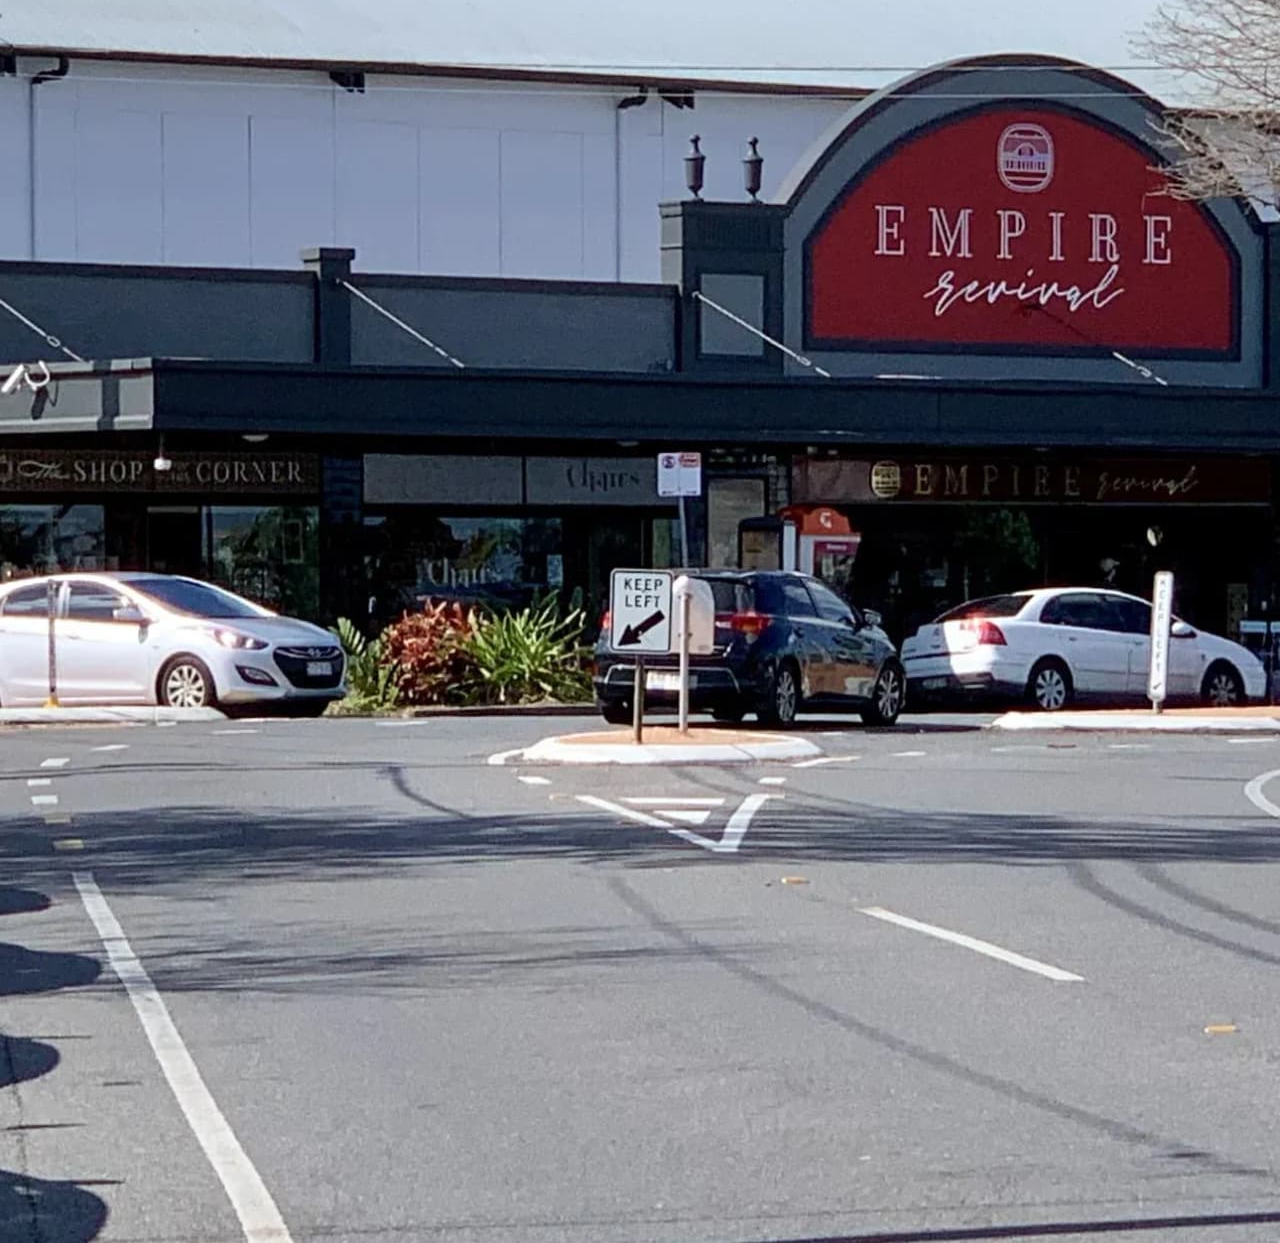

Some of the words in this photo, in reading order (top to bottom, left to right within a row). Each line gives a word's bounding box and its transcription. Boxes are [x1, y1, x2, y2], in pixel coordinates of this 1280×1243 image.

[874, 205, 1172, 264] EMPIRE
[924, 265, 1124, 316] revival
[73, 459, 144, 483] SHOP
[195, 460, 304, 484] CORNER
[913, 463, 1081, 496] EMPIRE
[624, 578, 663, 593] KEEP
[625, 594, 661, 608] LEFT
